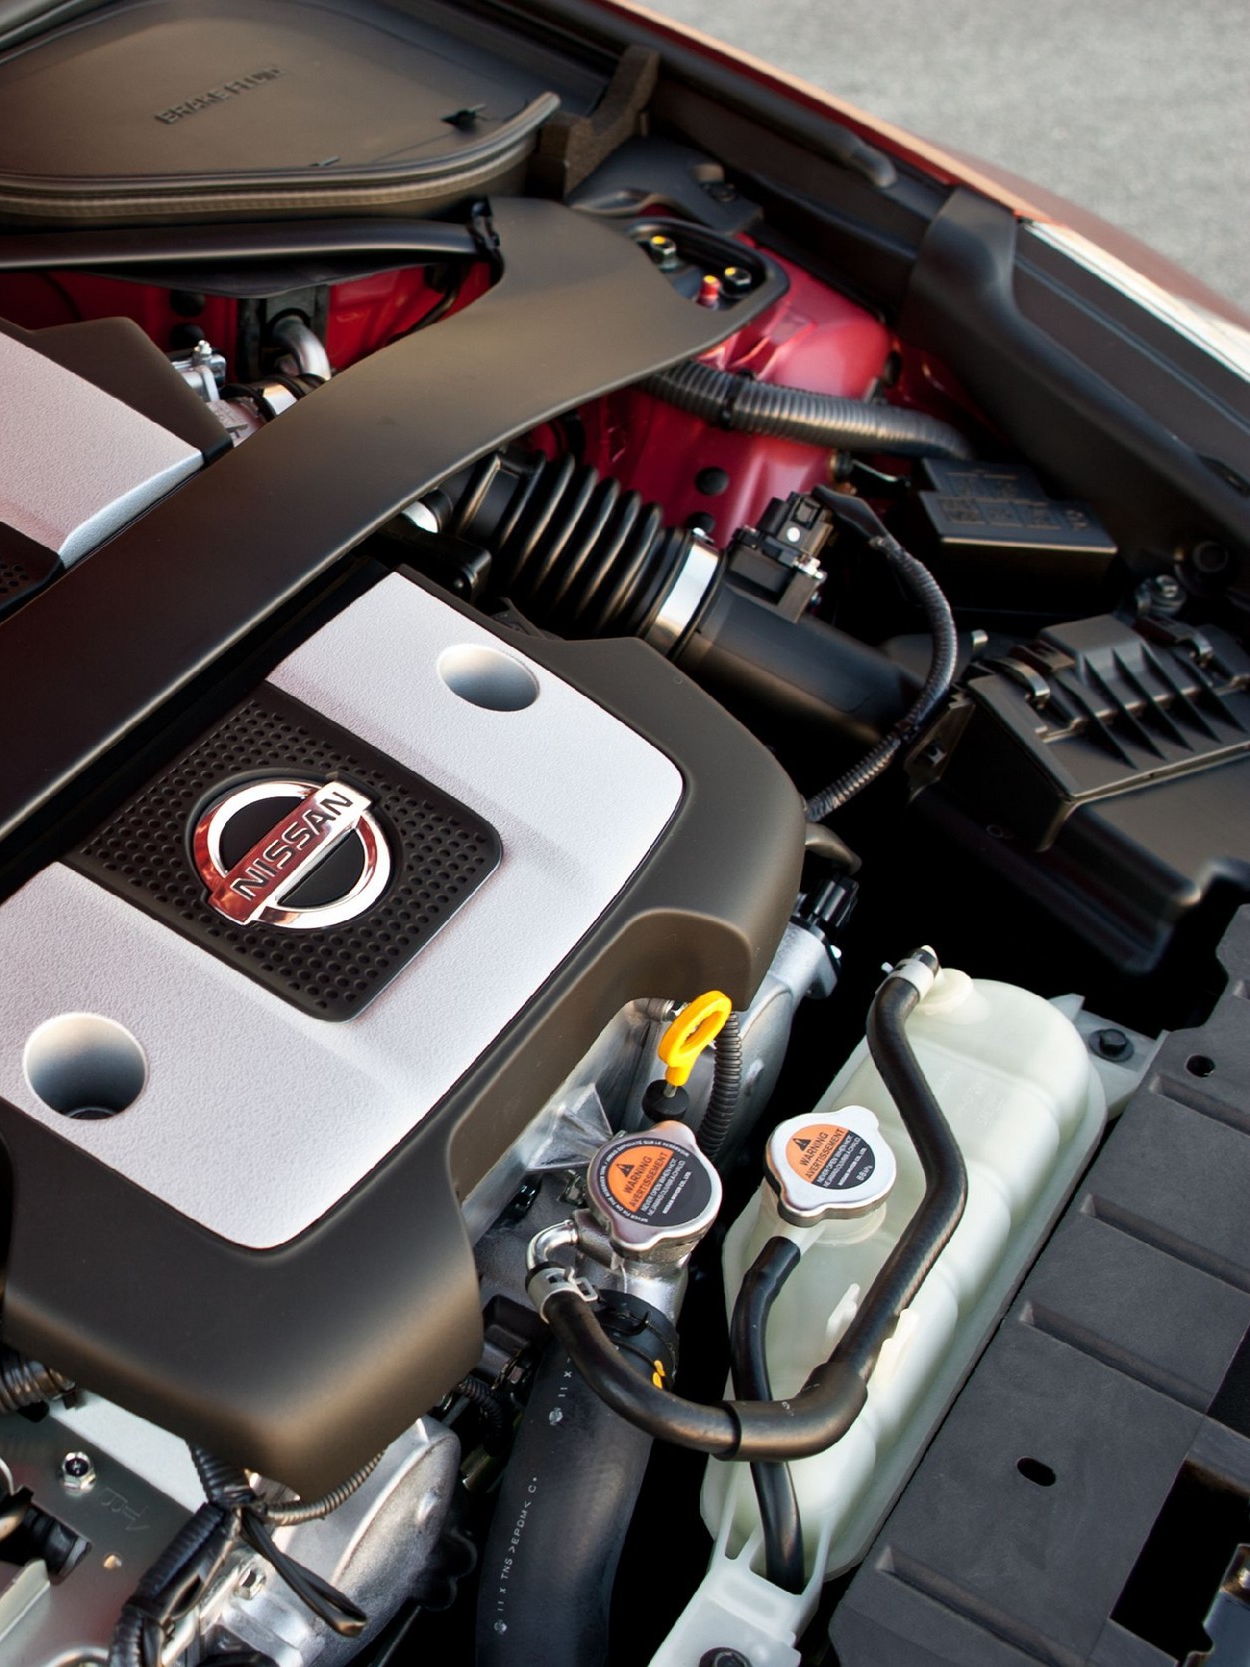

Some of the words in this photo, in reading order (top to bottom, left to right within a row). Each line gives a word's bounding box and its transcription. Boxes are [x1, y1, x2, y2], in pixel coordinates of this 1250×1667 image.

[153, 90, 229, 125] BRAKE
[229, 791, 354, 902] NISSAN
[799, 1131, 829, 1167] WARNING
[805, 1128, 845, 1179] AVERTISSEMENT
[623, 1155, 653, 1194] WARNING
[628, 1151, 669, 1207] AVERTISSEMENT
[500, 1557, 514, 1581] TNS
